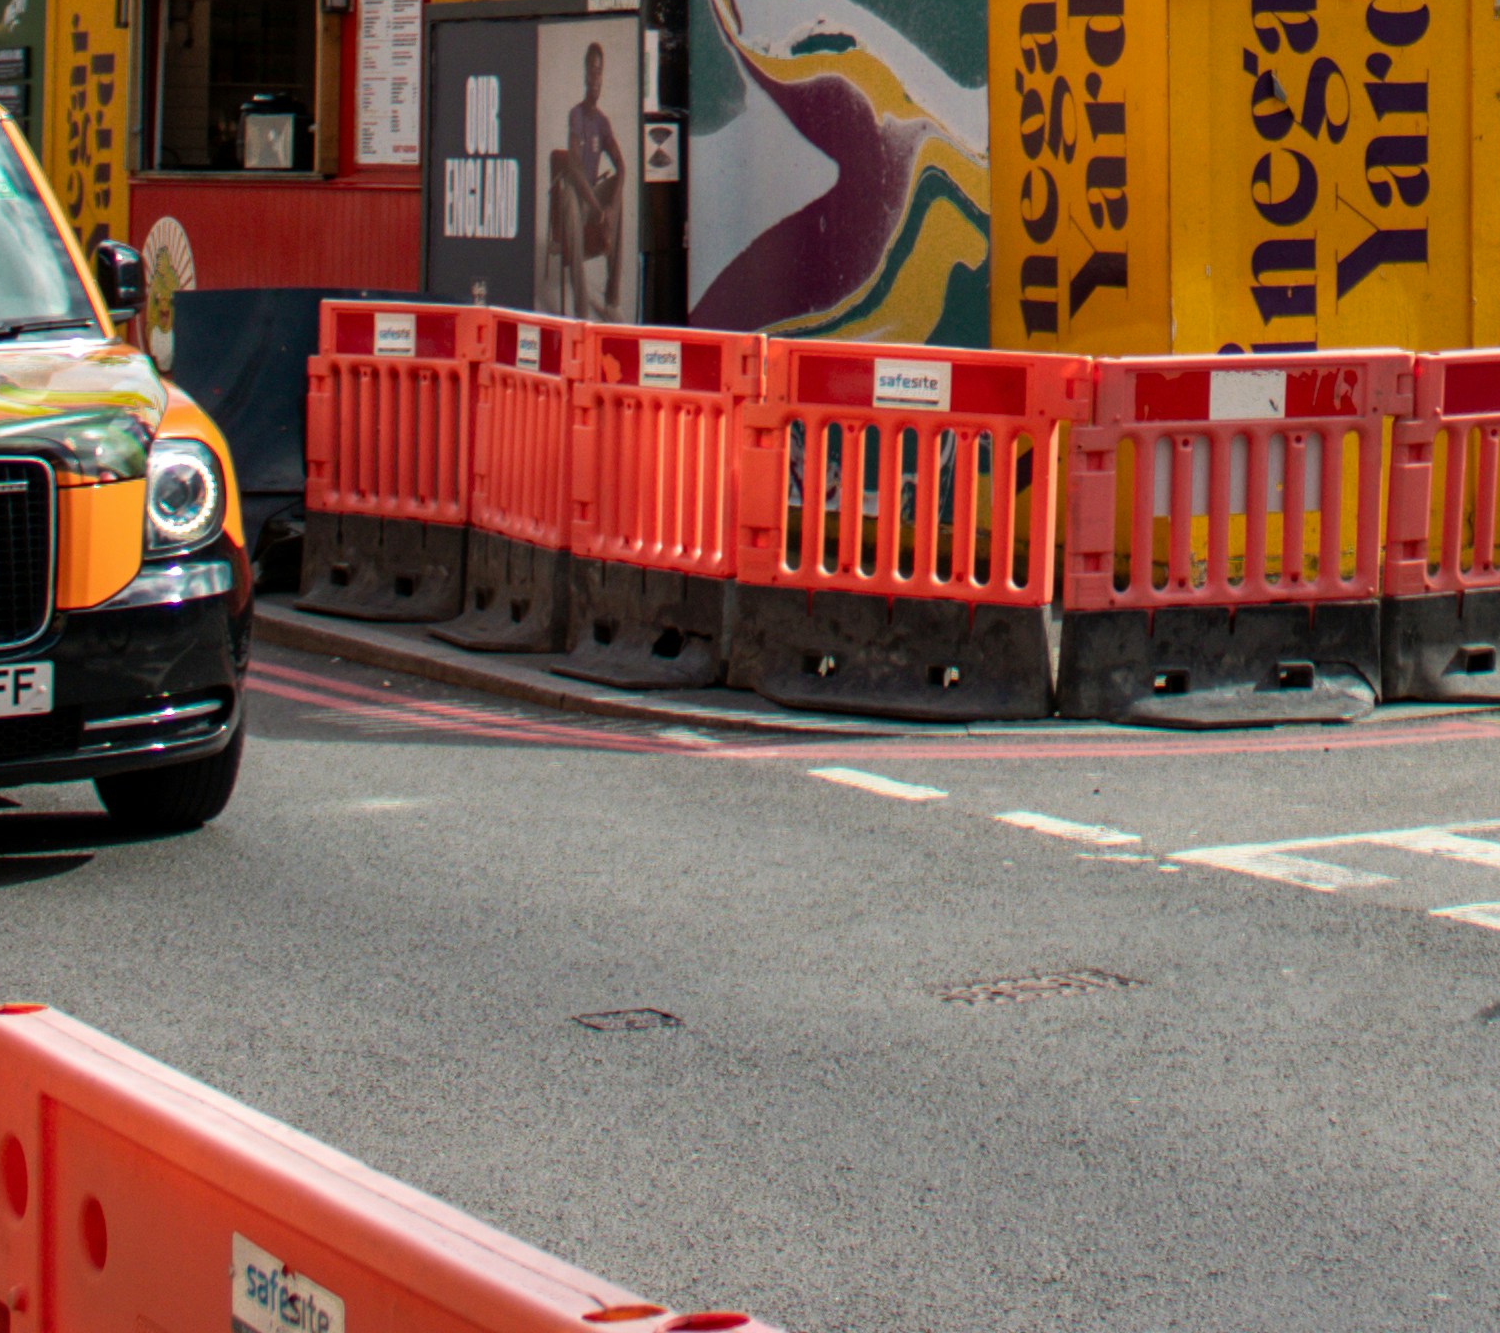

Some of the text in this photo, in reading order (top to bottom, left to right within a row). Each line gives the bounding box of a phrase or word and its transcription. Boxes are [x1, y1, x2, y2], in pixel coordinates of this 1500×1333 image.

[465, 74, 500, 155] OUR
[444, 158, 519, 239] ENGLAND
[378, 327, 411, 342] safesite
[643, 349, 677, 365] safesite
[878, 373, 939, 391] safesite
[245, 1263, 331, 1333] safesite
